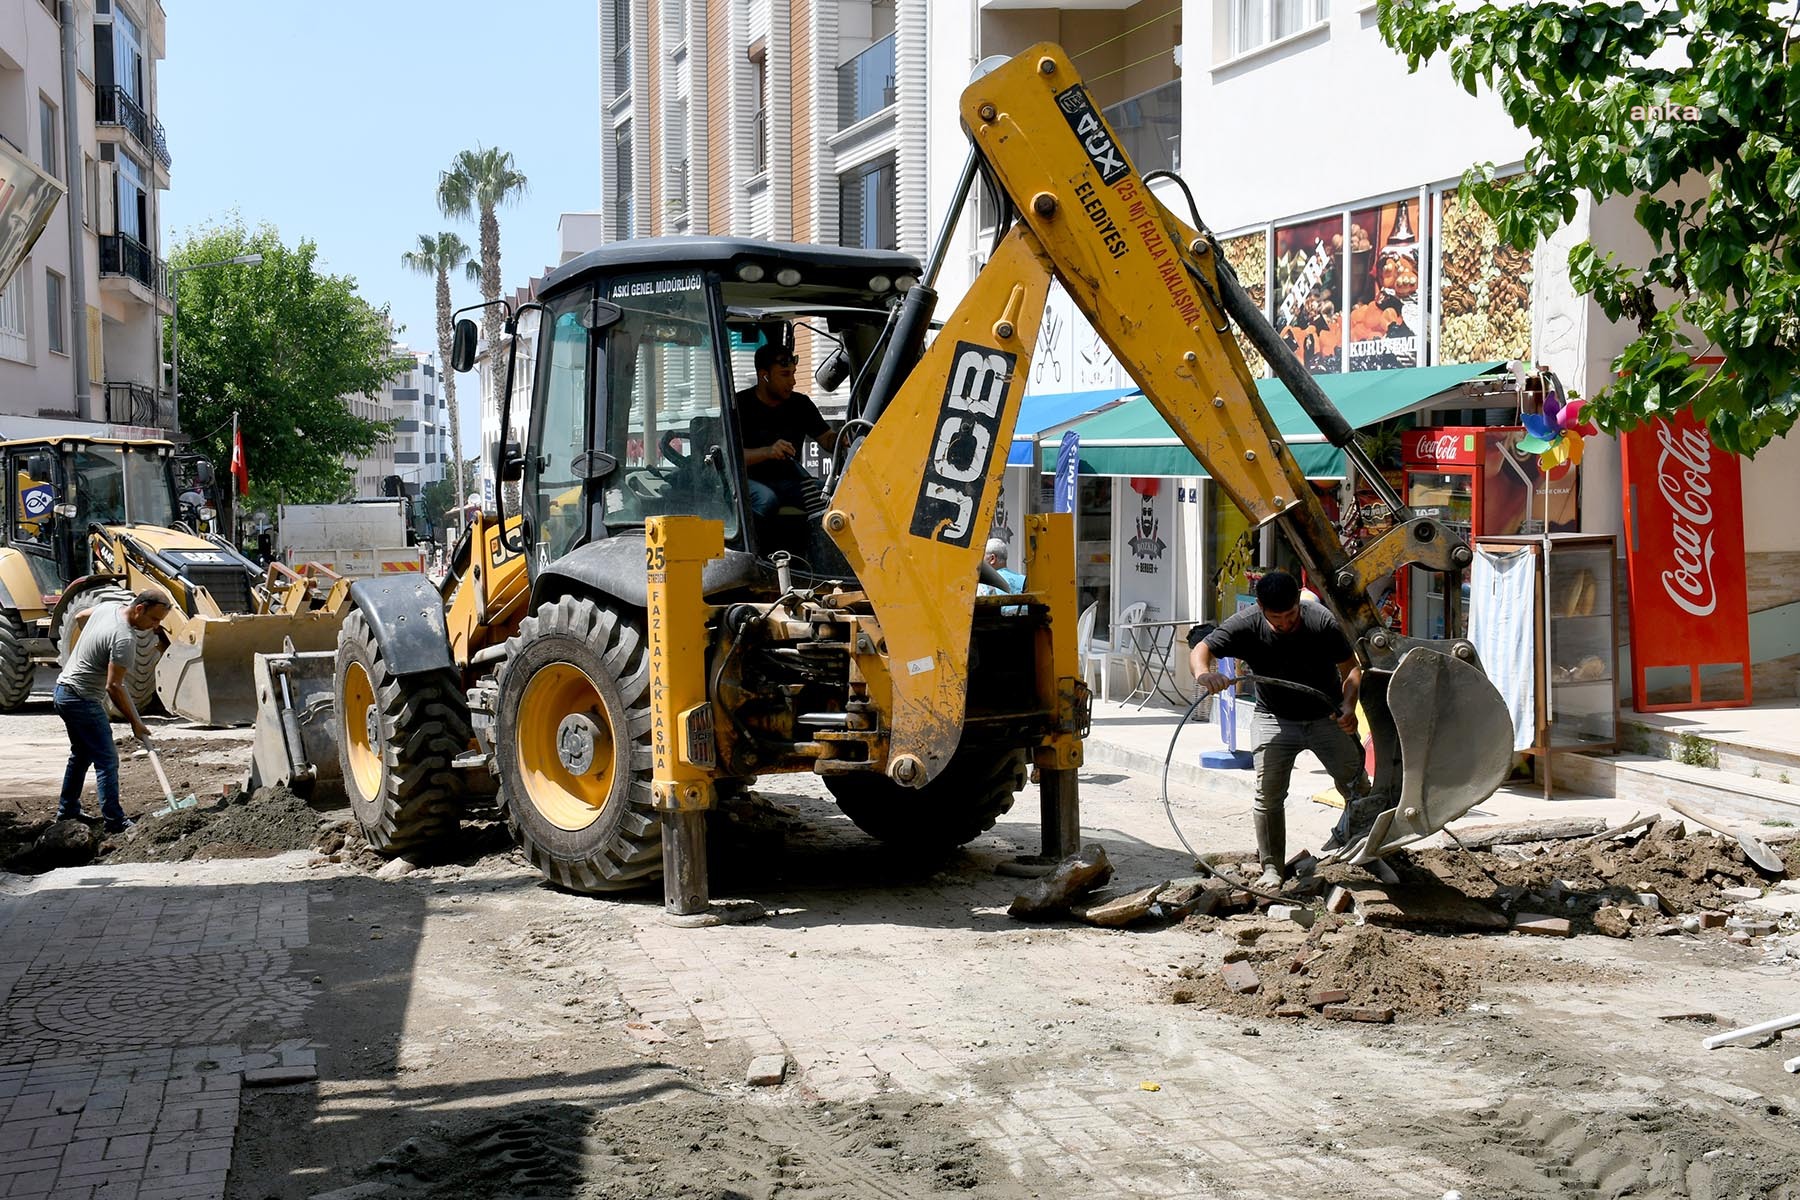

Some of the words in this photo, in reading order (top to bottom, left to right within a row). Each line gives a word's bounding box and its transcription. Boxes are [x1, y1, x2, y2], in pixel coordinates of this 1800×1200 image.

[612, 282, 630, 298] ASKİ
[631, 282, 655, 296] GENEL
[655, 275, 701, 293] MÜDÜRLÜĞÜ
[1136, 217, 1168, 261] FAZLA
[1158, 258, 1201, 327] YAKLAŞMA
[925, 351, 1007, 539] JCB
[492, 527, 523, 565] JC
[1656, 416, 1717, 616] Coca-Cola
[646, 547, 665, 570] 25
[652, 591, 662, 657] FAZLA
